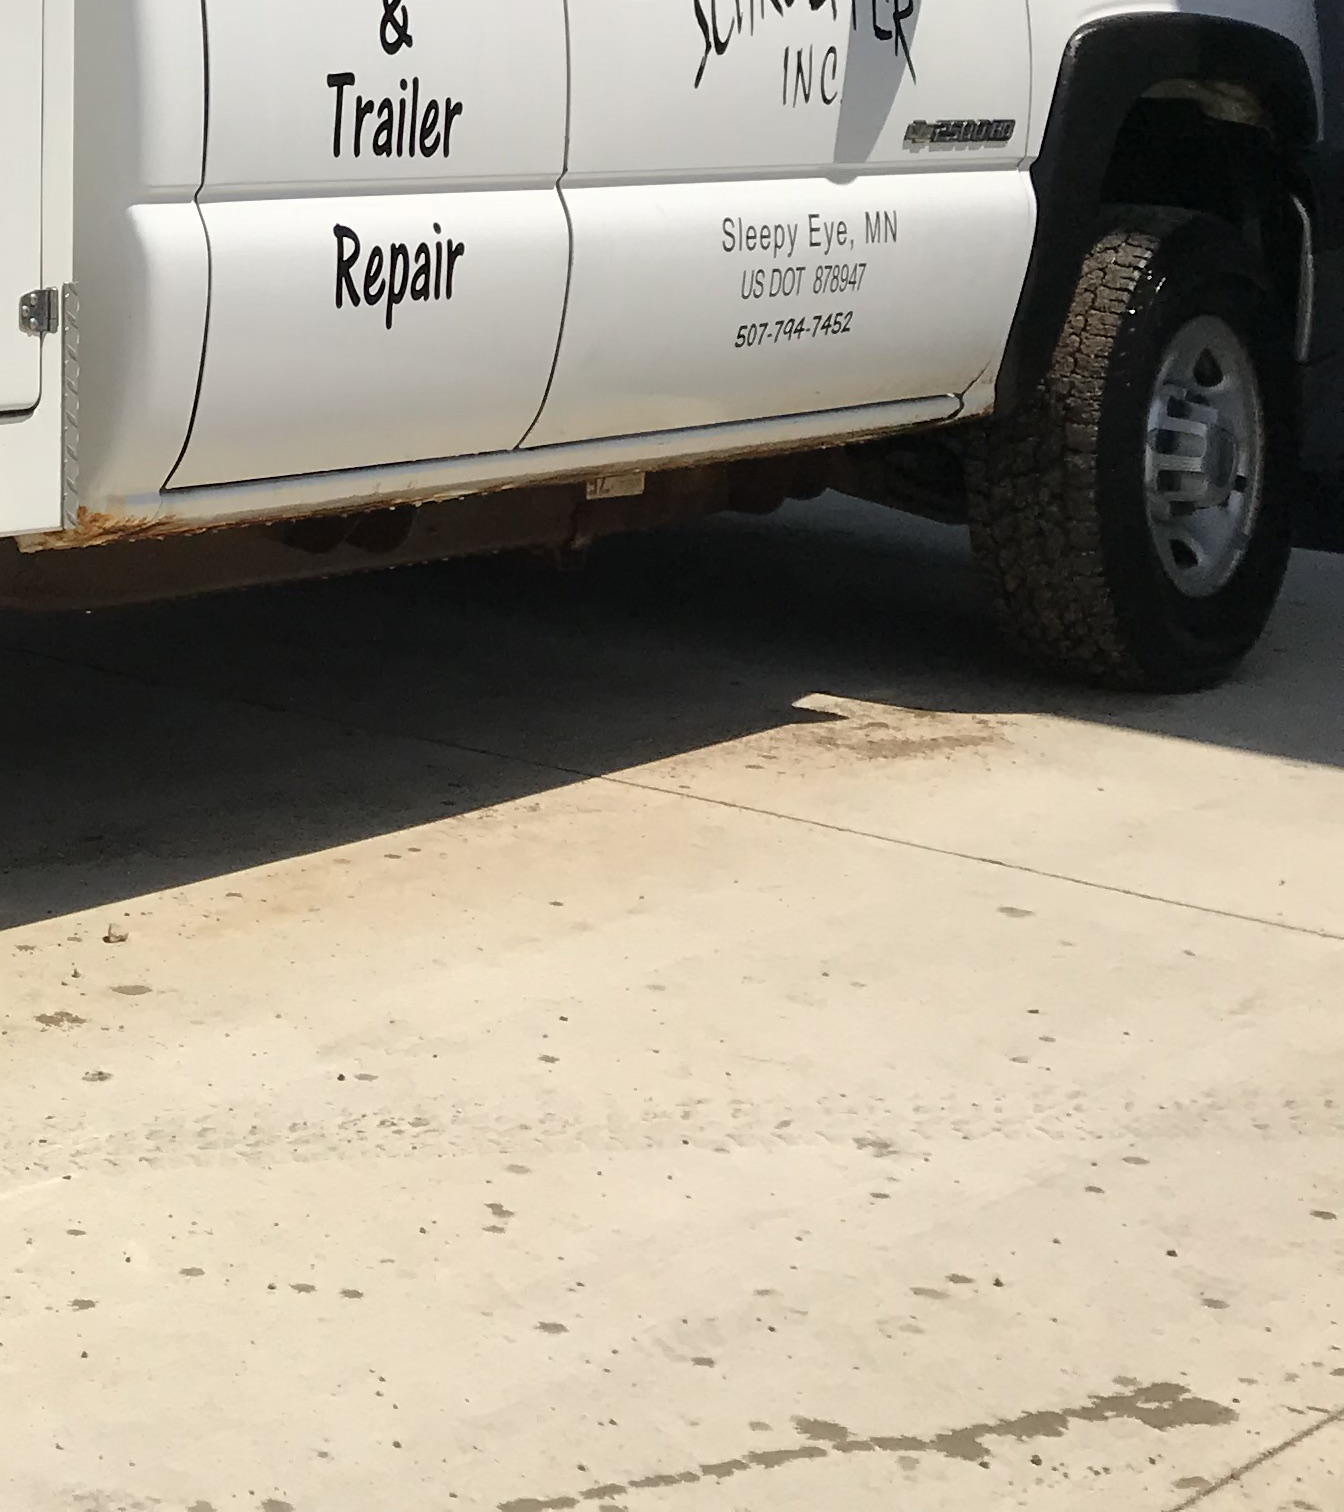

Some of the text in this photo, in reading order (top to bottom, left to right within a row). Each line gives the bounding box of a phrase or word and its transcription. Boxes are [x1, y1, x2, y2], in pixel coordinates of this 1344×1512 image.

[326, 72, 463, 158] Trailer
[721, 210, 898, 259] Sleepy Eye, MN
[333, 222, 465, 330] Repair
[741, 262, 868, 300] US DOT 878947
[734, 310, 854, 349] 507-794-7452
